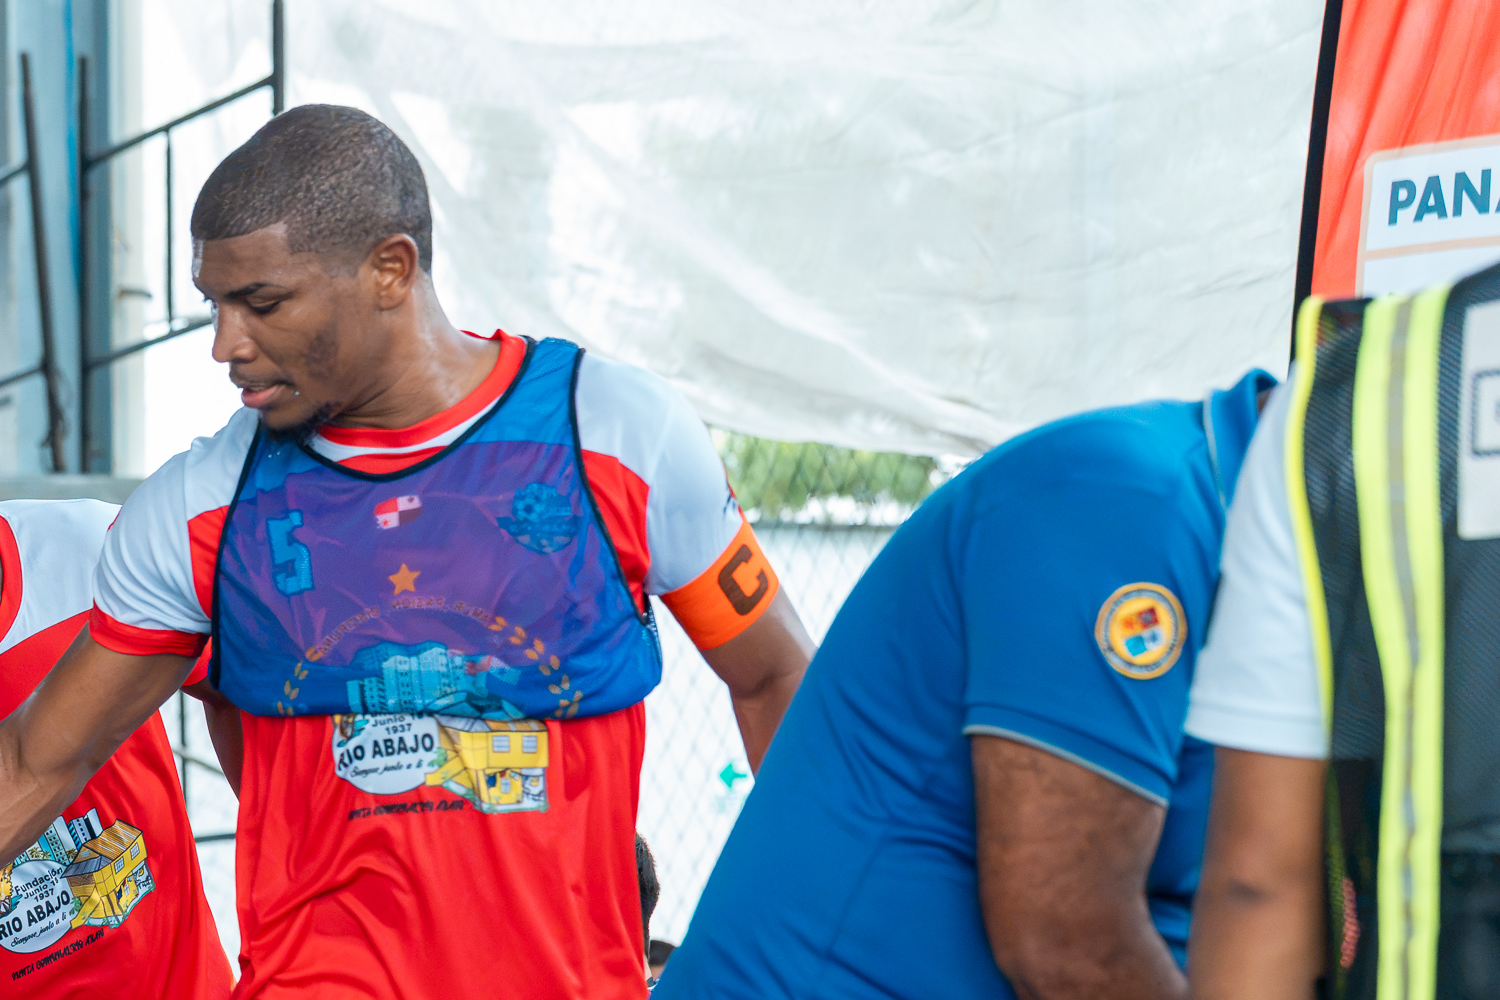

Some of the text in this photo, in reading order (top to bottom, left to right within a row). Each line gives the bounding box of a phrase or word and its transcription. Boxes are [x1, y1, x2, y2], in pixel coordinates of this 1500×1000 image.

[1388, 168, 1500, 226] PAN
[266, 510, 315, 596] 5
[718, 544, 769, 615] C
[385, 723, 412, 735] 1937
[337, 733, 434, 771] RIO ABAJO
[14, 867, 63, 895] Fundación
[24, 884, 48, 899] Junio
[34, 888, 54, 903] 1937
[27, 890, 70, 927] ABAJO
